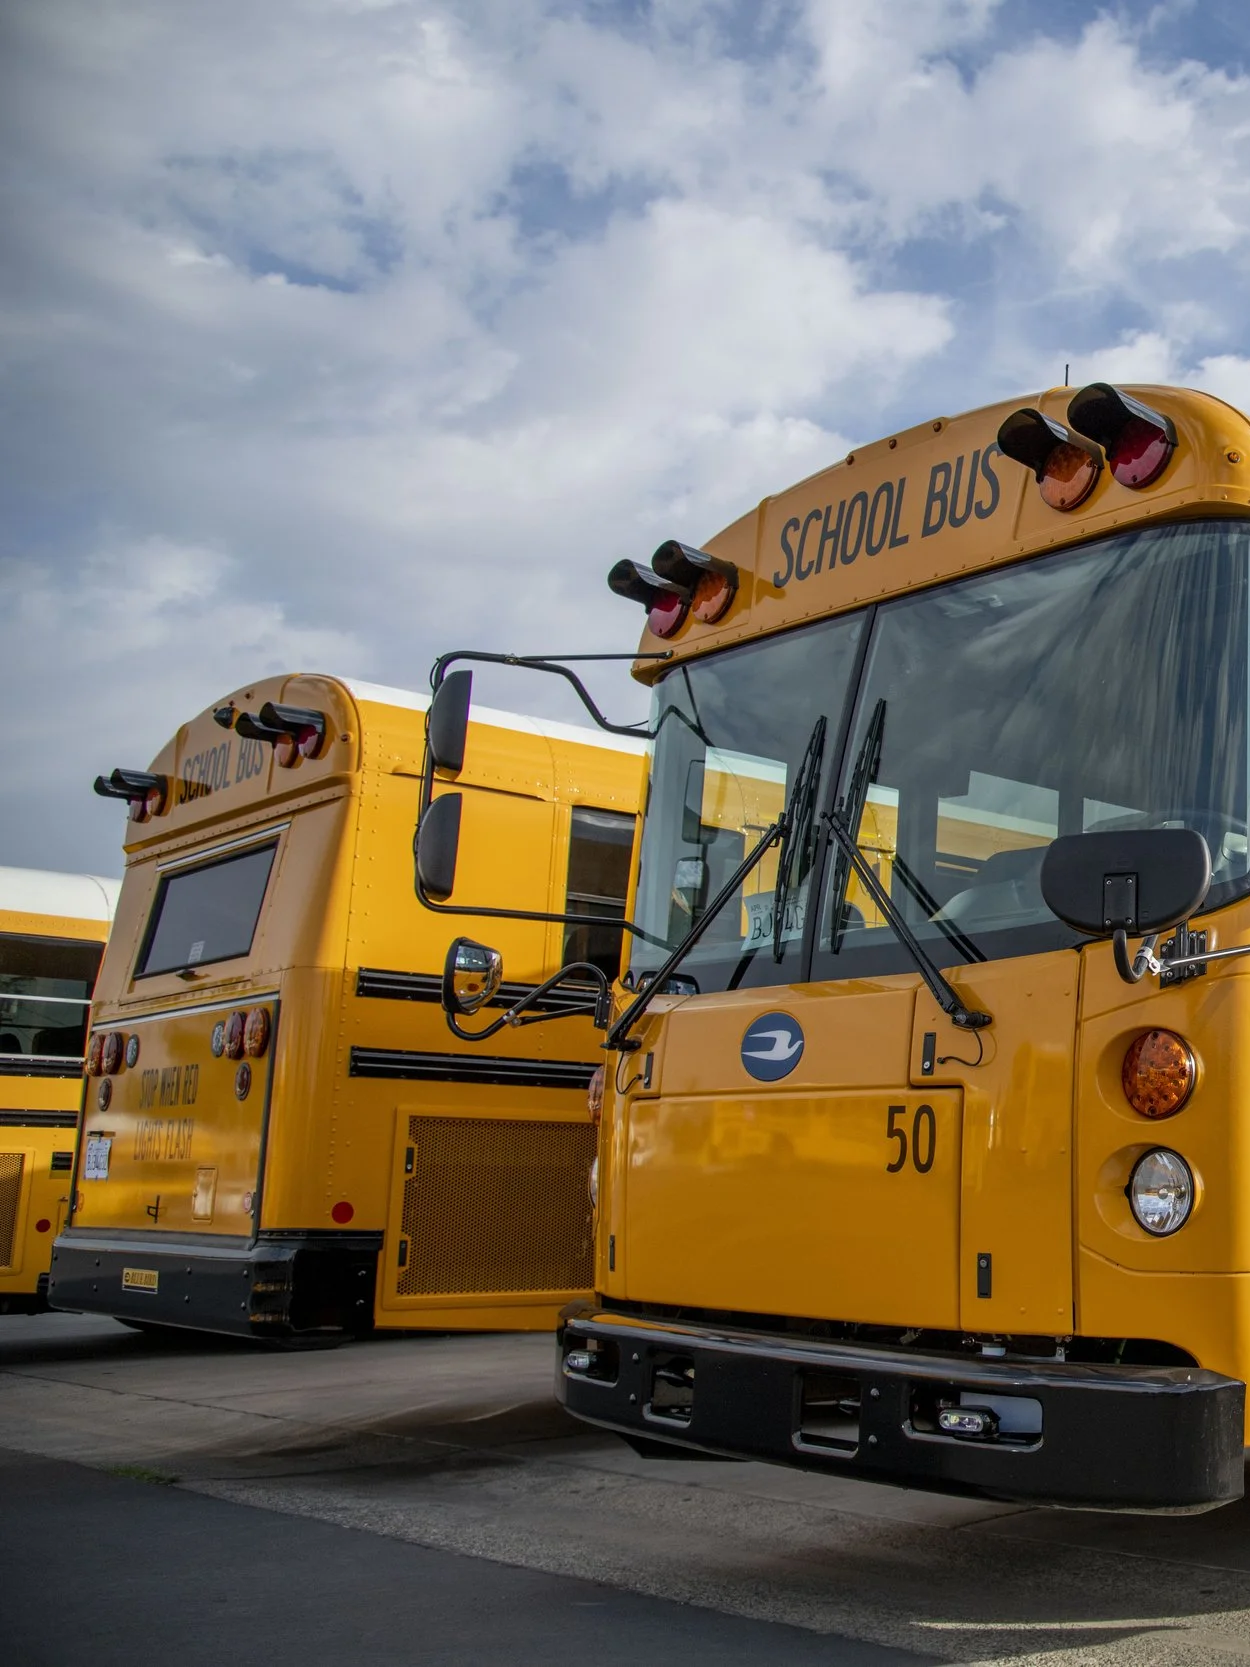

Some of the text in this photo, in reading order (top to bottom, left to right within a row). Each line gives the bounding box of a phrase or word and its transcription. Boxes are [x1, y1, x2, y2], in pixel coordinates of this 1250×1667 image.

[773, 441, 1004, 588] SCHOOL BUS
[179, 738, 264, 804] SCHOOL BUS
[140, 1064, 199, 1109] STOP WHEN RED
[133, 1119, 163, 1161] LIGHTS
[164, 1118, 194, 1160] FLASH
[886, 1104, 936, 1173] 50
